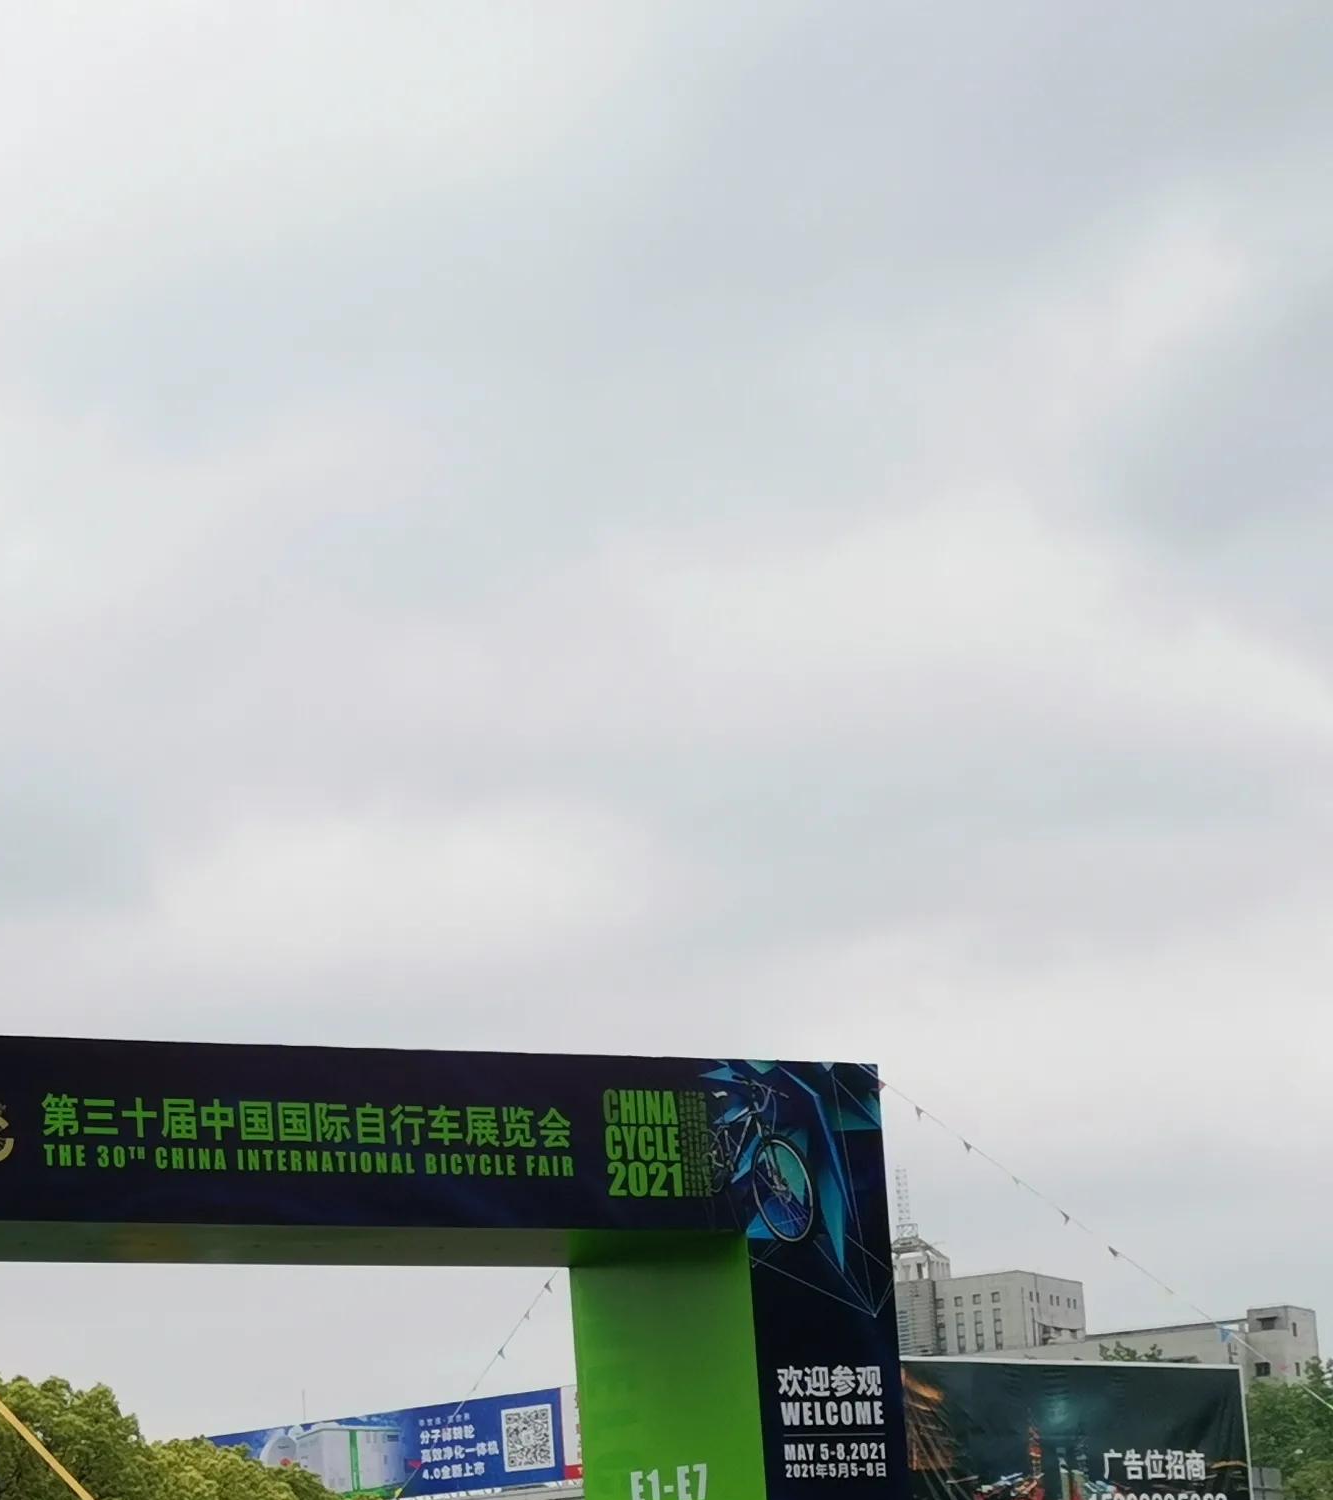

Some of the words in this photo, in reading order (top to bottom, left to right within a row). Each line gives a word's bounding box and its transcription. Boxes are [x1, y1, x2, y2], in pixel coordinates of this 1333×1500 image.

[41, 1092, 572, 1149] 第三十届中国国际自行车展览会
[603, 1089, 679, 1125] CHINA
[605, 1124, 681, 1162] CYCLE
[44, 1143, 85, 1168] THE
[154, 1147, 227, 1171] CHINA
[236, 1148, 415, 1176] INTERNATIONAL
[424, 1152, 518, 1178] BICYCLE
[526, 1155, 576, 1179] FAIR
[607, 1160, 684, 1198] 2021
[776, 1364, 884, 1398] 欢迎参观
[780, 1400, 885, 1426] WELCOME
[783, 1443, 815, 1461] MAY
[819, 1442, 886, 1461] 5-8,2021
[1102, 1448, 1207, 1481] 广告位招商
[784, 1462, 887, 1479] 2021年5月5~8日
